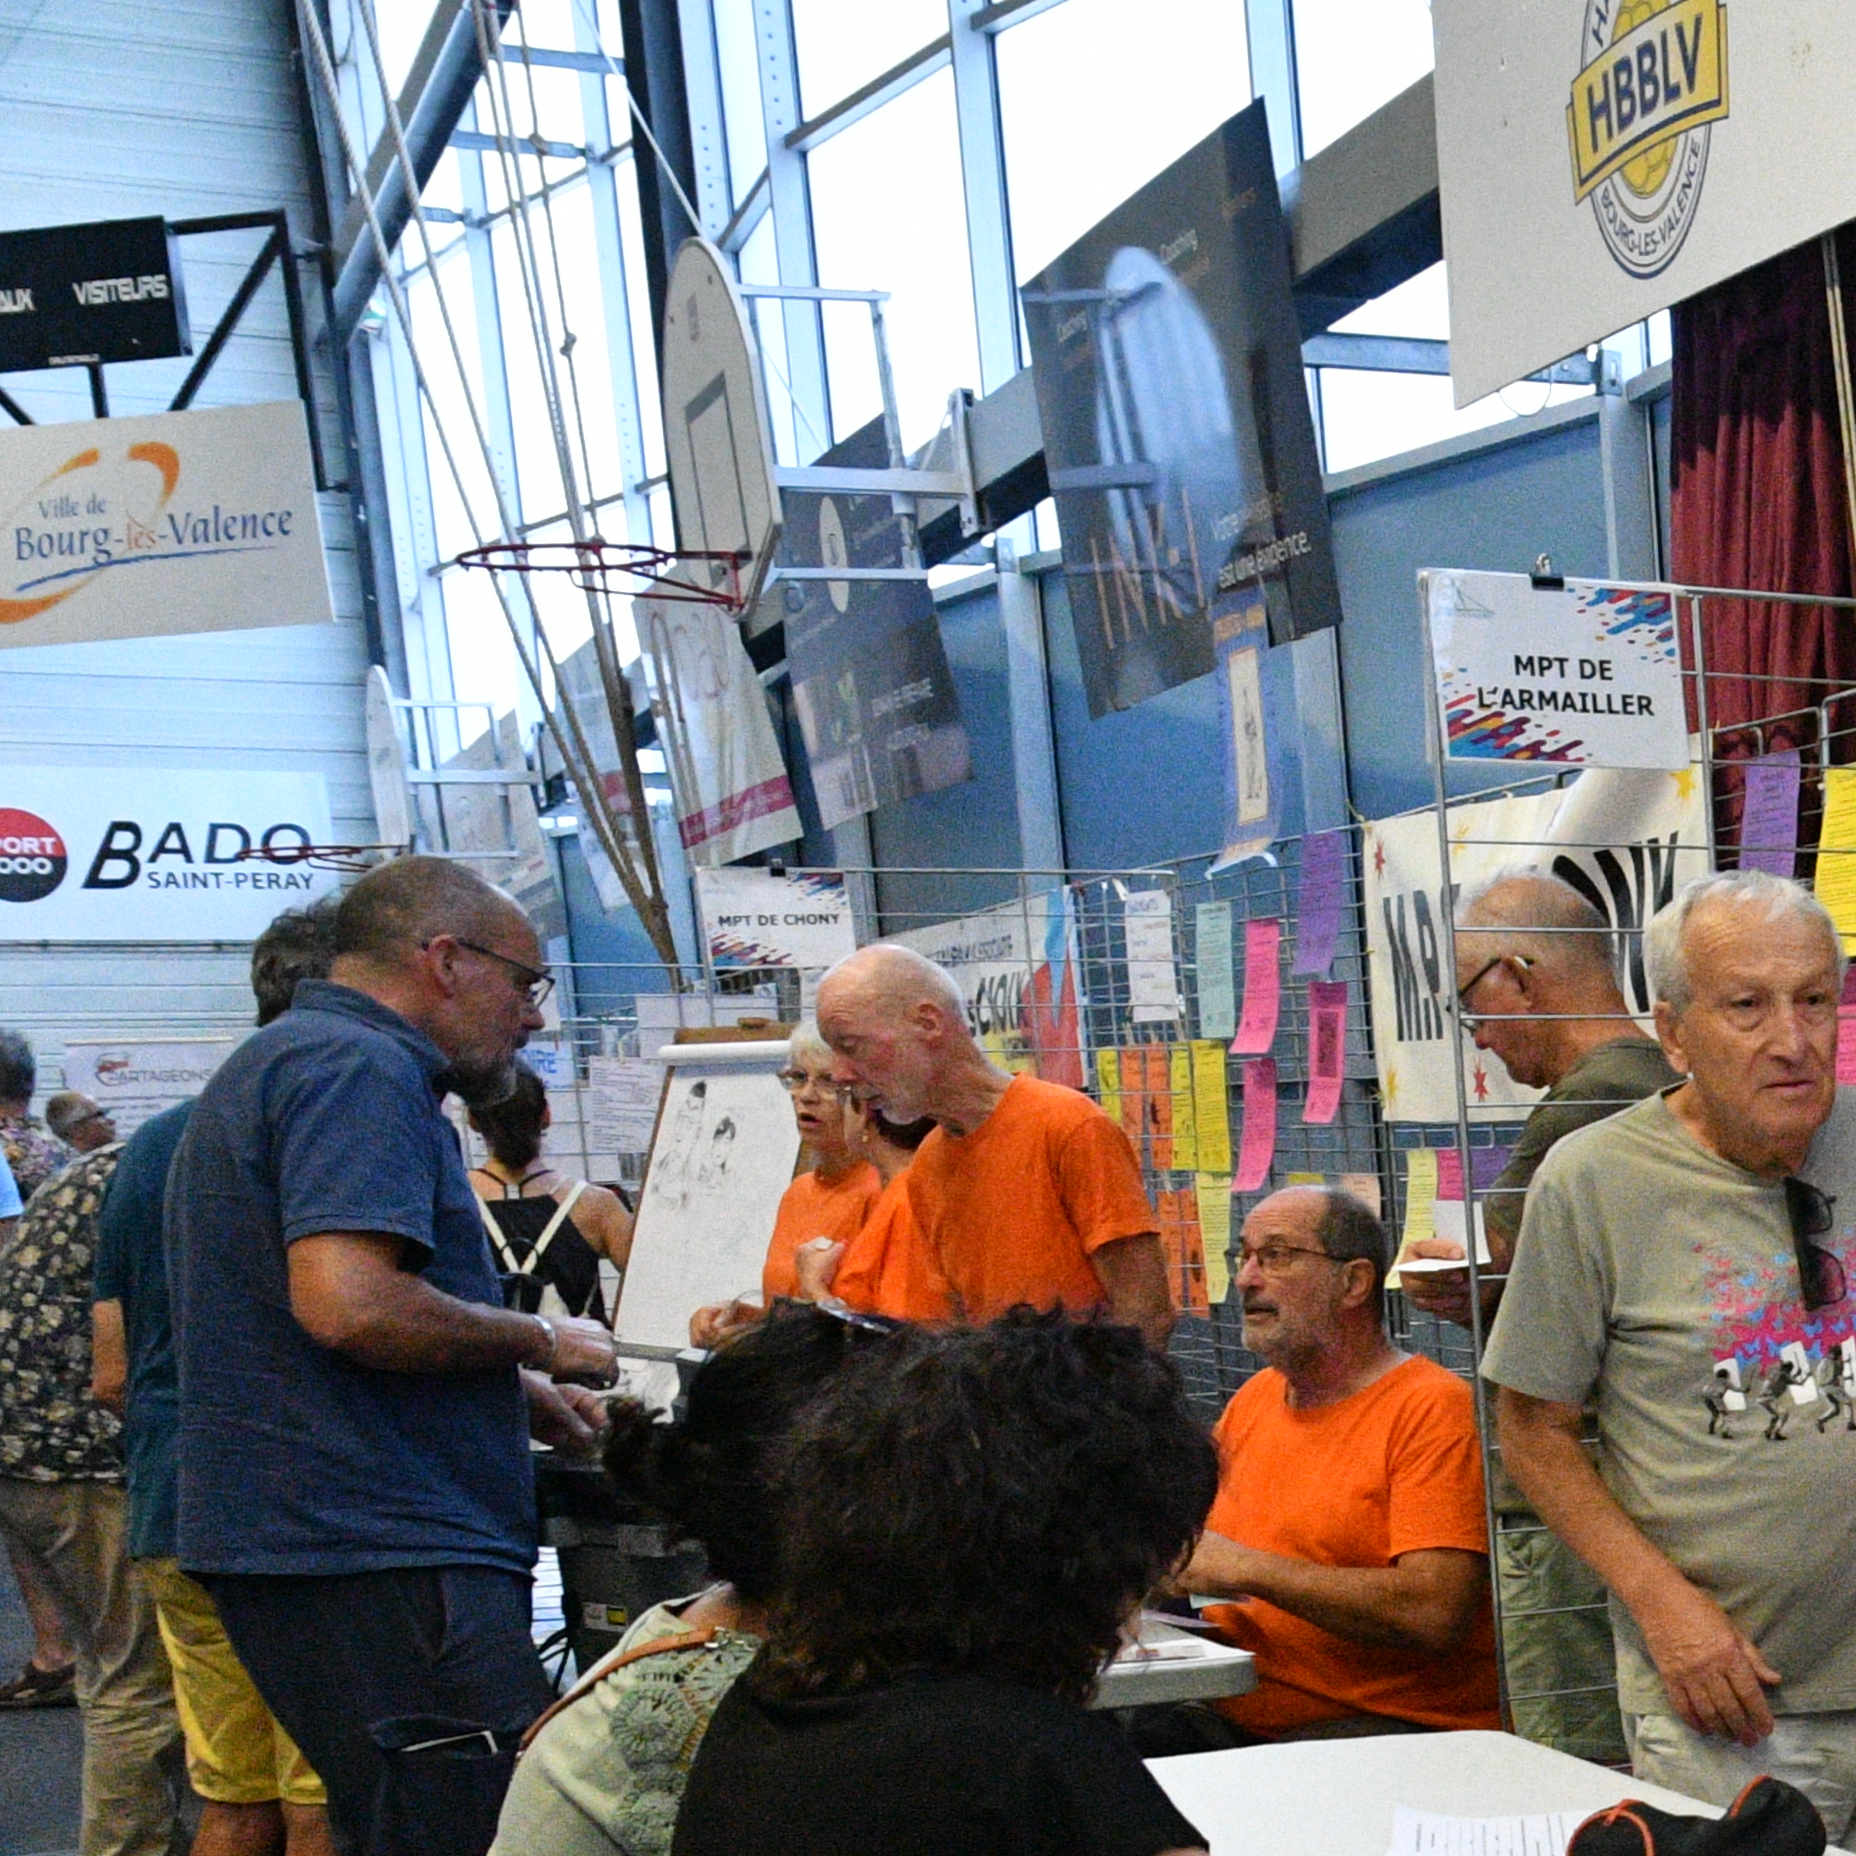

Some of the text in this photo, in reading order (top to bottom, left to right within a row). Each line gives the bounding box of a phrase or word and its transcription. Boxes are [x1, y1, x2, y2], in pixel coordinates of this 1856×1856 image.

[1587, 13, 1703, 153] HBBLV
[72, 275, 170, 306] VISITEURS
[38, 493, 106, 519] Ville de
[1513, 655, 1614, 681] MPT DE
[1477, 686, 1656, 716] L'ARMAILLER
[0, 836, 57, 855] ORT
[81, 821, 312, 889] BADO
[147, 871, 314, 890] SAINT-PERAY
[718, 913, 840, 927] MPT DE CHONY
